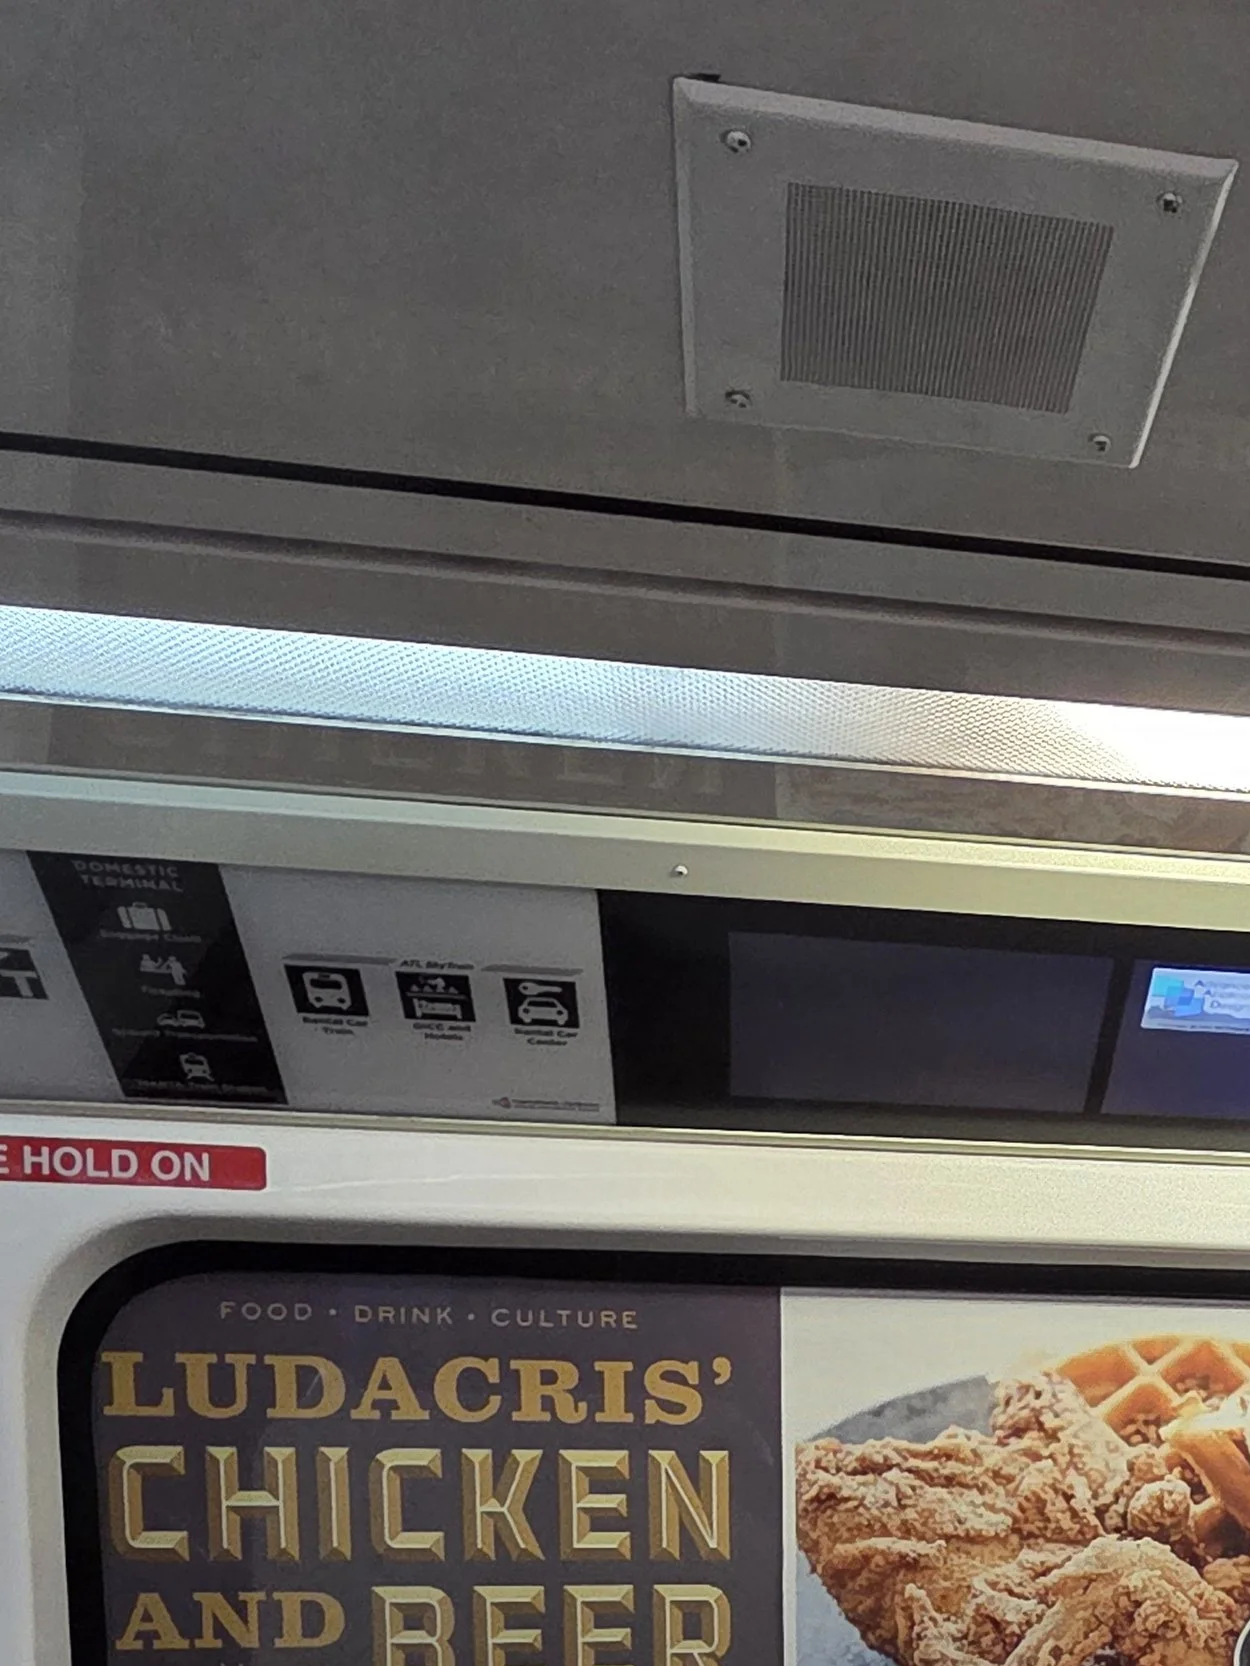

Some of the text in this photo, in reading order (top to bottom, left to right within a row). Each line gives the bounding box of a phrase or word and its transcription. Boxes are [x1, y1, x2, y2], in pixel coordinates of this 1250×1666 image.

[72, 860, 179, 878] DOMESTIC
[23, 1144, 139, 1179] HOLD
[150, 1149, 210, 1182] ON
[220, 1301, 639, 1330] FOOD DRINK CULTURE
[108, 1444, 732, 1562] CHICKEN
[115, 1591, 346, 1650] AND
